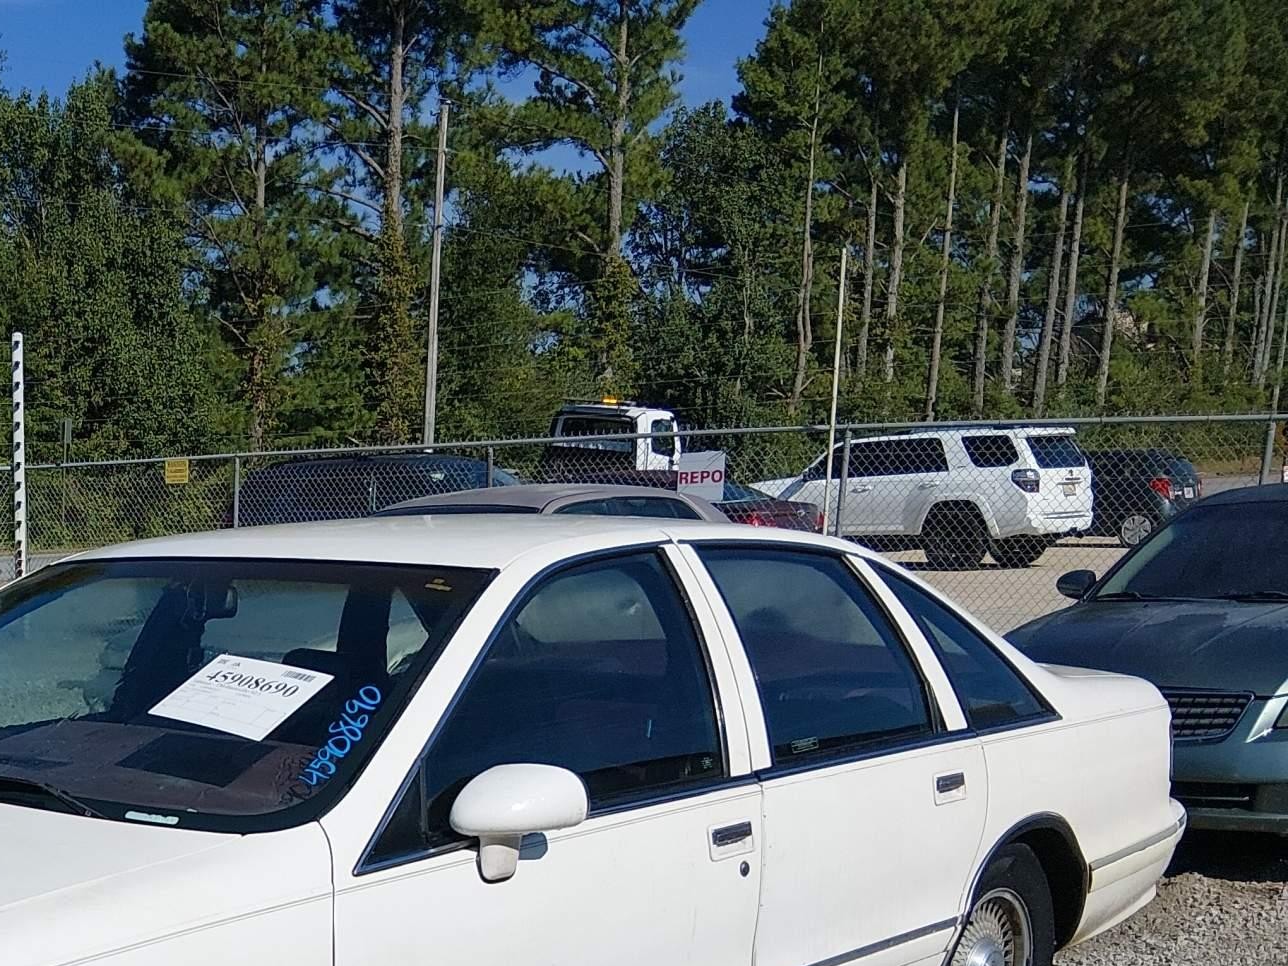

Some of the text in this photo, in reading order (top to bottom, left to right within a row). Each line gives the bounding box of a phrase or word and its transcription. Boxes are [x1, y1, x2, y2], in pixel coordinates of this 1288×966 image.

[678, 470, 723, 485] REPO
[206, 670, 300, 698] 45908690
[298, 685, 382, 786] 45908690
